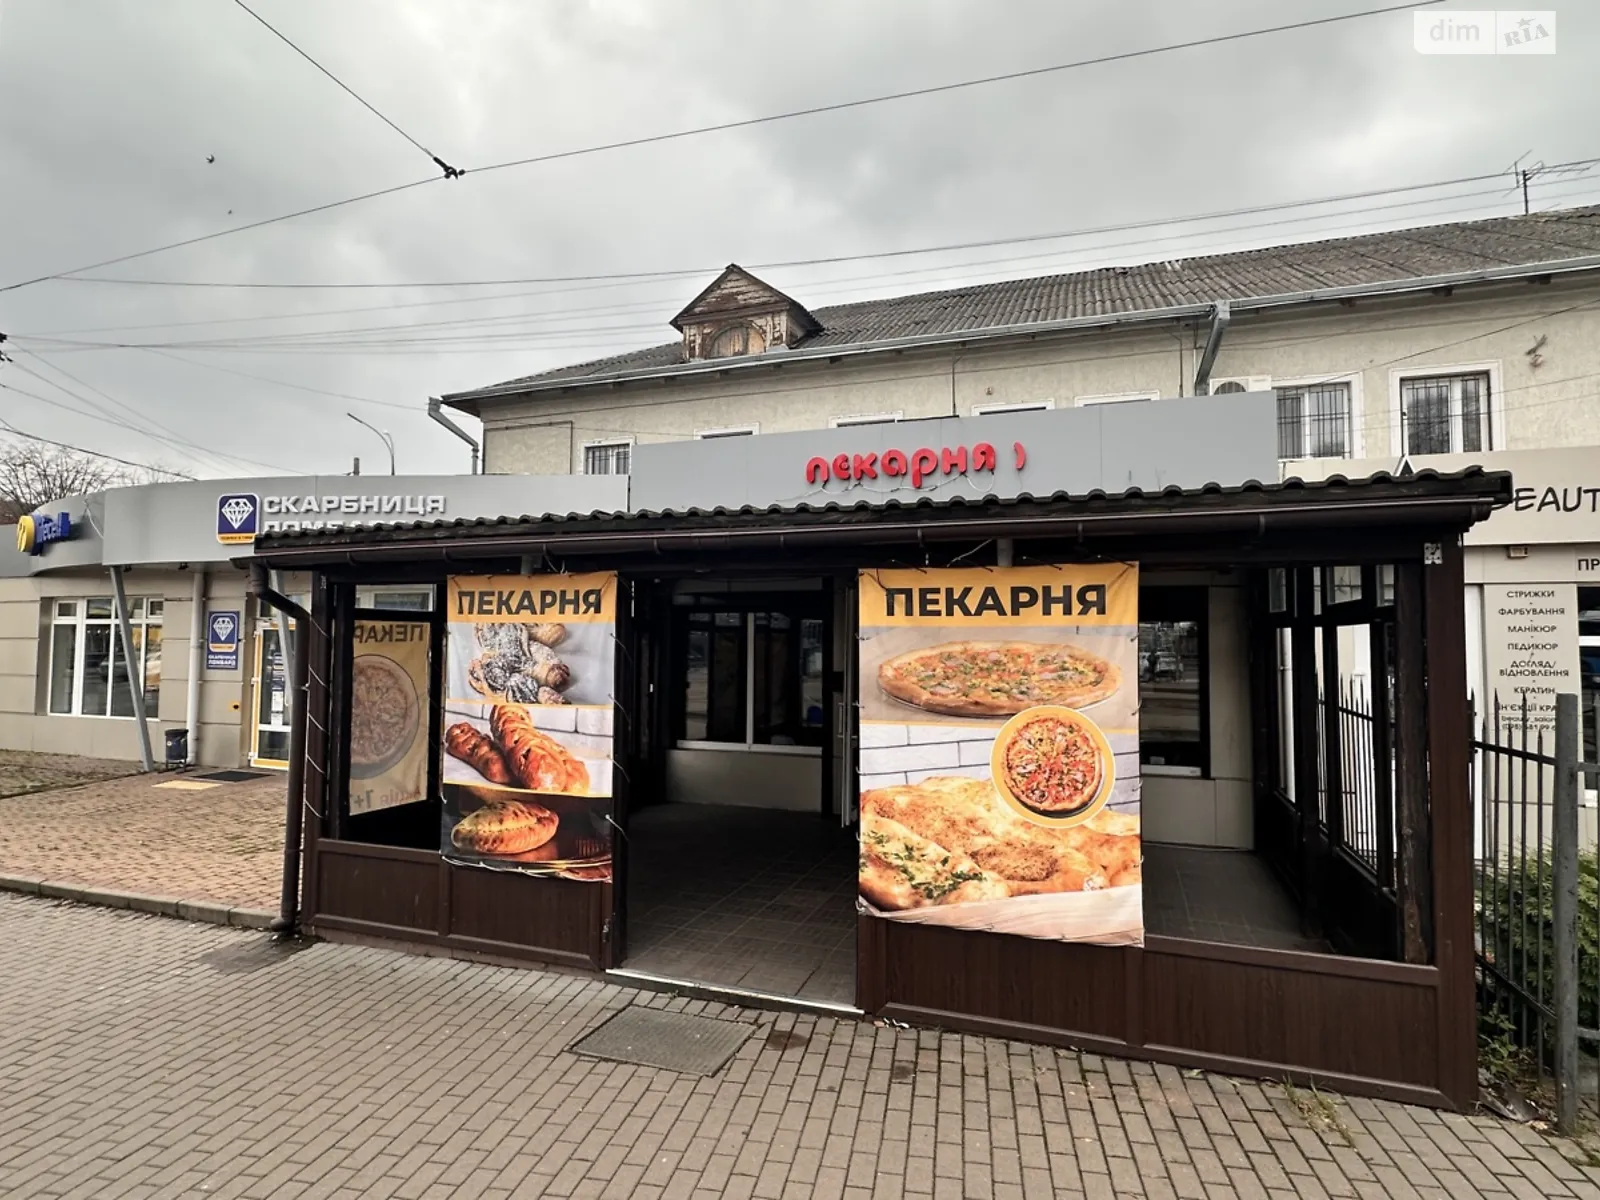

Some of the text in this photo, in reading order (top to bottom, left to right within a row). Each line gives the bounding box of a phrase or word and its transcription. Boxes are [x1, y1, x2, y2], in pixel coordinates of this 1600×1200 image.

[806, 442, 996, 489] пекарня
[263, 495, 446, 515] СКАРБНИЦЯ
[457, 589, 601, 615] ПЕКАРНЯ
[886, 584, 1106, 616] ПЕКАРНЯ
[1506, 590, 1555, 598] СТРИЖКИ
[1498, 607, 1566, 616] ФАРБУВАННЯ
[1507, 643, 1558, 651] ПЕДИКЮР
